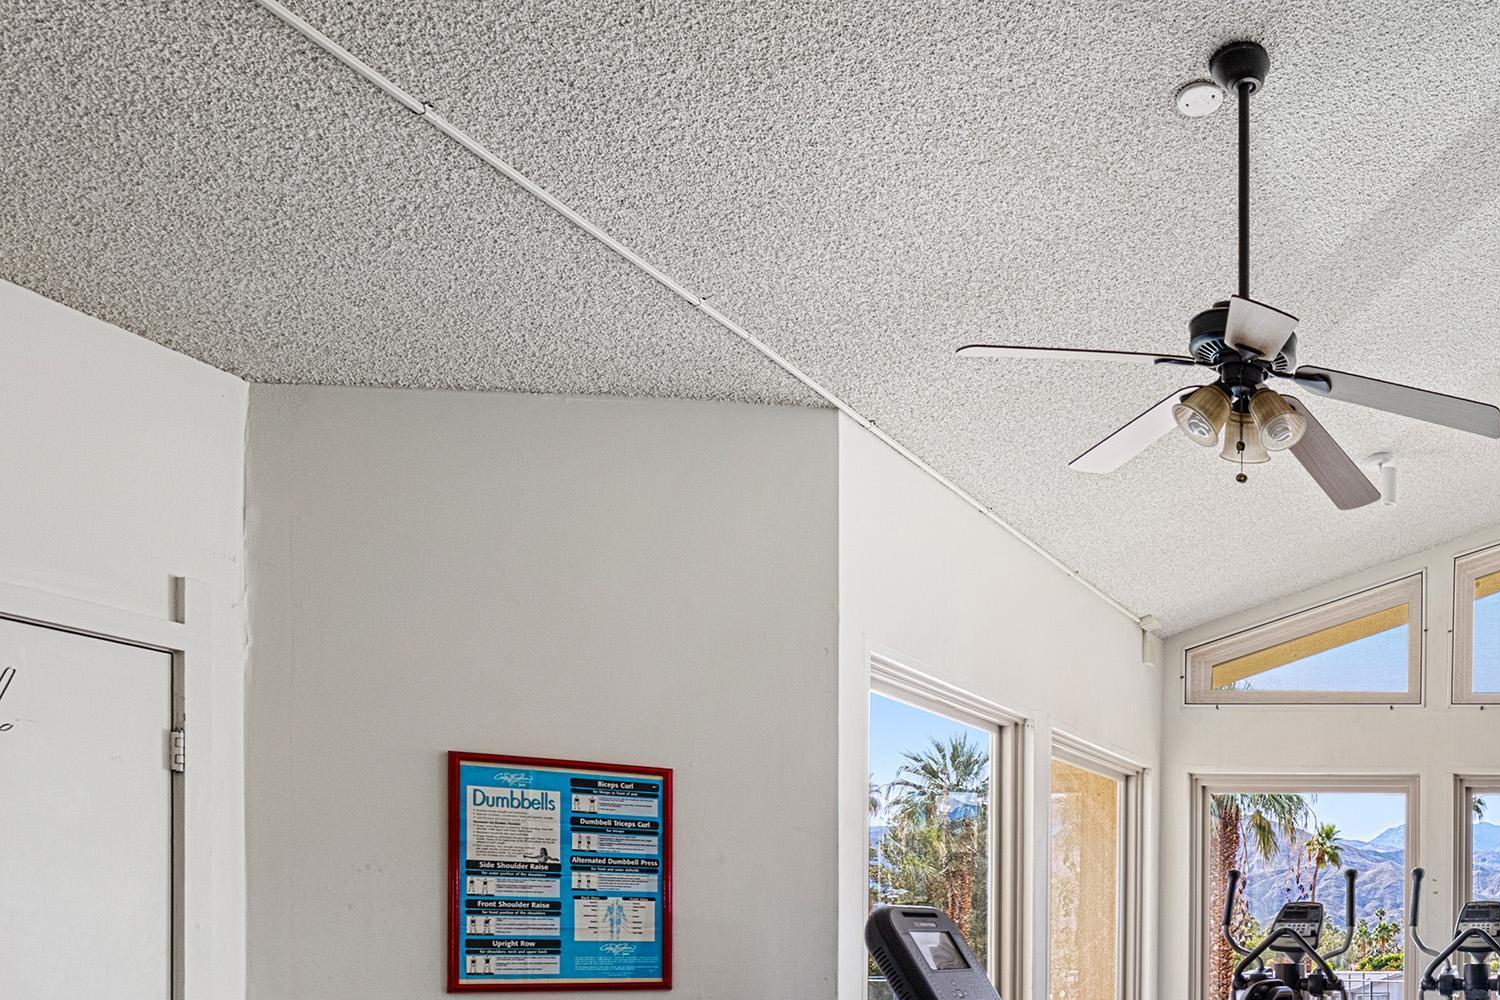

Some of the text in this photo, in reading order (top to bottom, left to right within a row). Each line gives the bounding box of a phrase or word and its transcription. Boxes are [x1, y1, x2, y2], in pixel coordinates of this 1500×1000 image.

[597, 781, 619, 789] Biceps
[473, 788, 556, 811] Dumbbells
[580, 818, 612, 826] Dumbbell
[614, 820, 636, 828] Triceps
[496, 862, 528, 870] Shoulder
[492, 940, 519, 948] Upright
